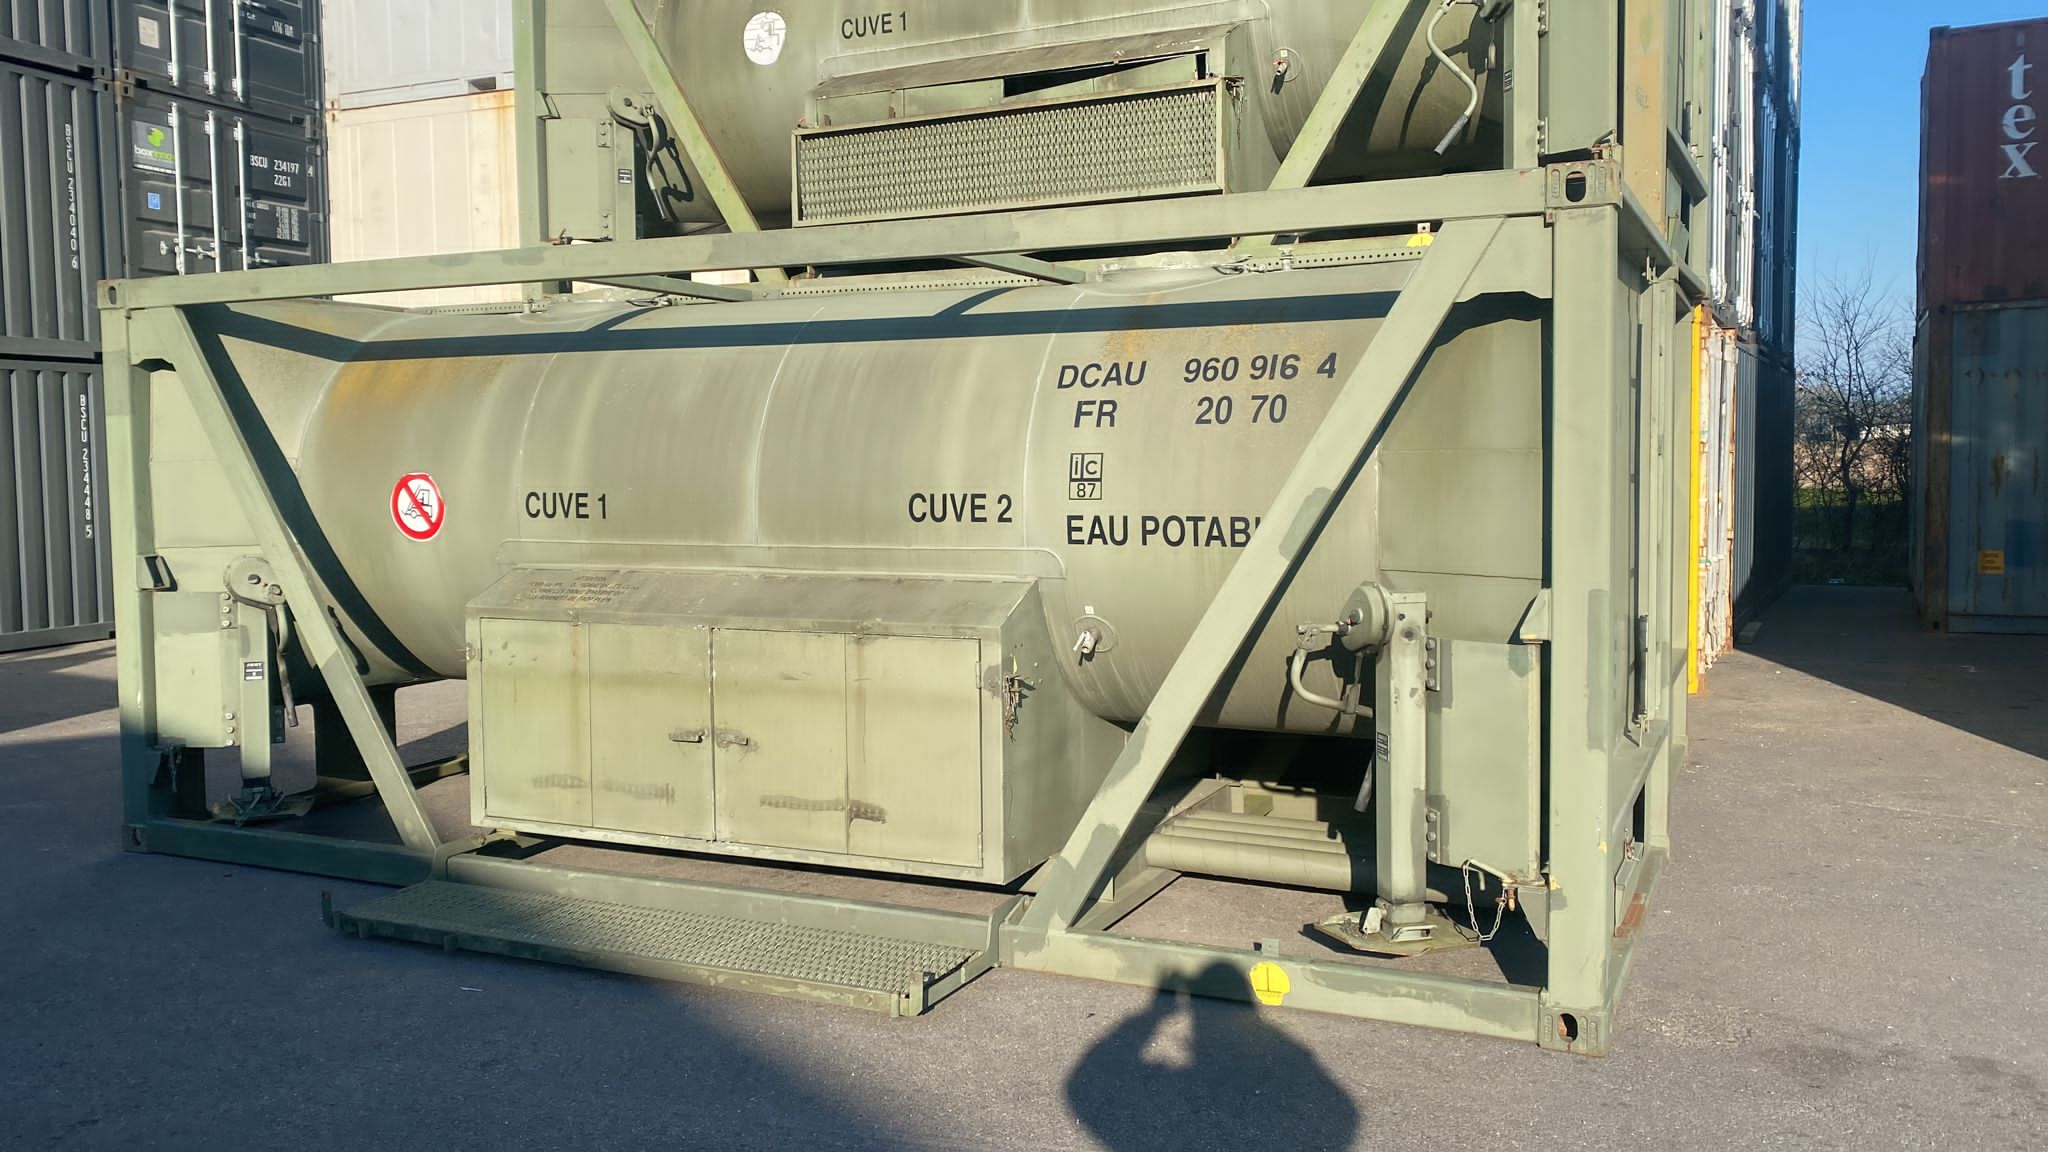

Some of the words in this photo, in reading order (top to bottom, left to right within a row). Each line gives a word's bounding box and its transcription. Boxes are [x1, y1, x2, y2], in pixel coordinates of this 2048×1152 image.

[841, 12, 893, 39] CUVE
[899, 10, 906, 31] 1
[1998, 54, 2039, 178] tex
[64, 123, 73, 173] BSCU
[273, 159, 299, 175] 234197
[67, 177, 77, 251] 234040
[71, 255, 79, 270] 6
[1057, 360, 1147, 389] DCAU
[1183, 356, 1239, 383] 960
[1249, 353, 1300, 380] 916
[1317, 352, 1337, 379] 4
[80, 394, 88, 443] BSCU
[1073, 399, 1118, 428] FR
[1195, 396, 1233, 425] 20
[1250, 394, 1287, 423] 70
[82, 448, 92, 521] 234448
[1077, 482, 1097, 498] 87
[525, 491, 589, 519] CUVE
[597, 493, 607, 520] 1
[908, 492, 988, 523] CUVE
[997, 494, 1013, 523] 2
[85, 525, 93, 538] 5
[1066, 514, 1129, 546] EAU
[1141, 515, 1261, 548] POTAB
